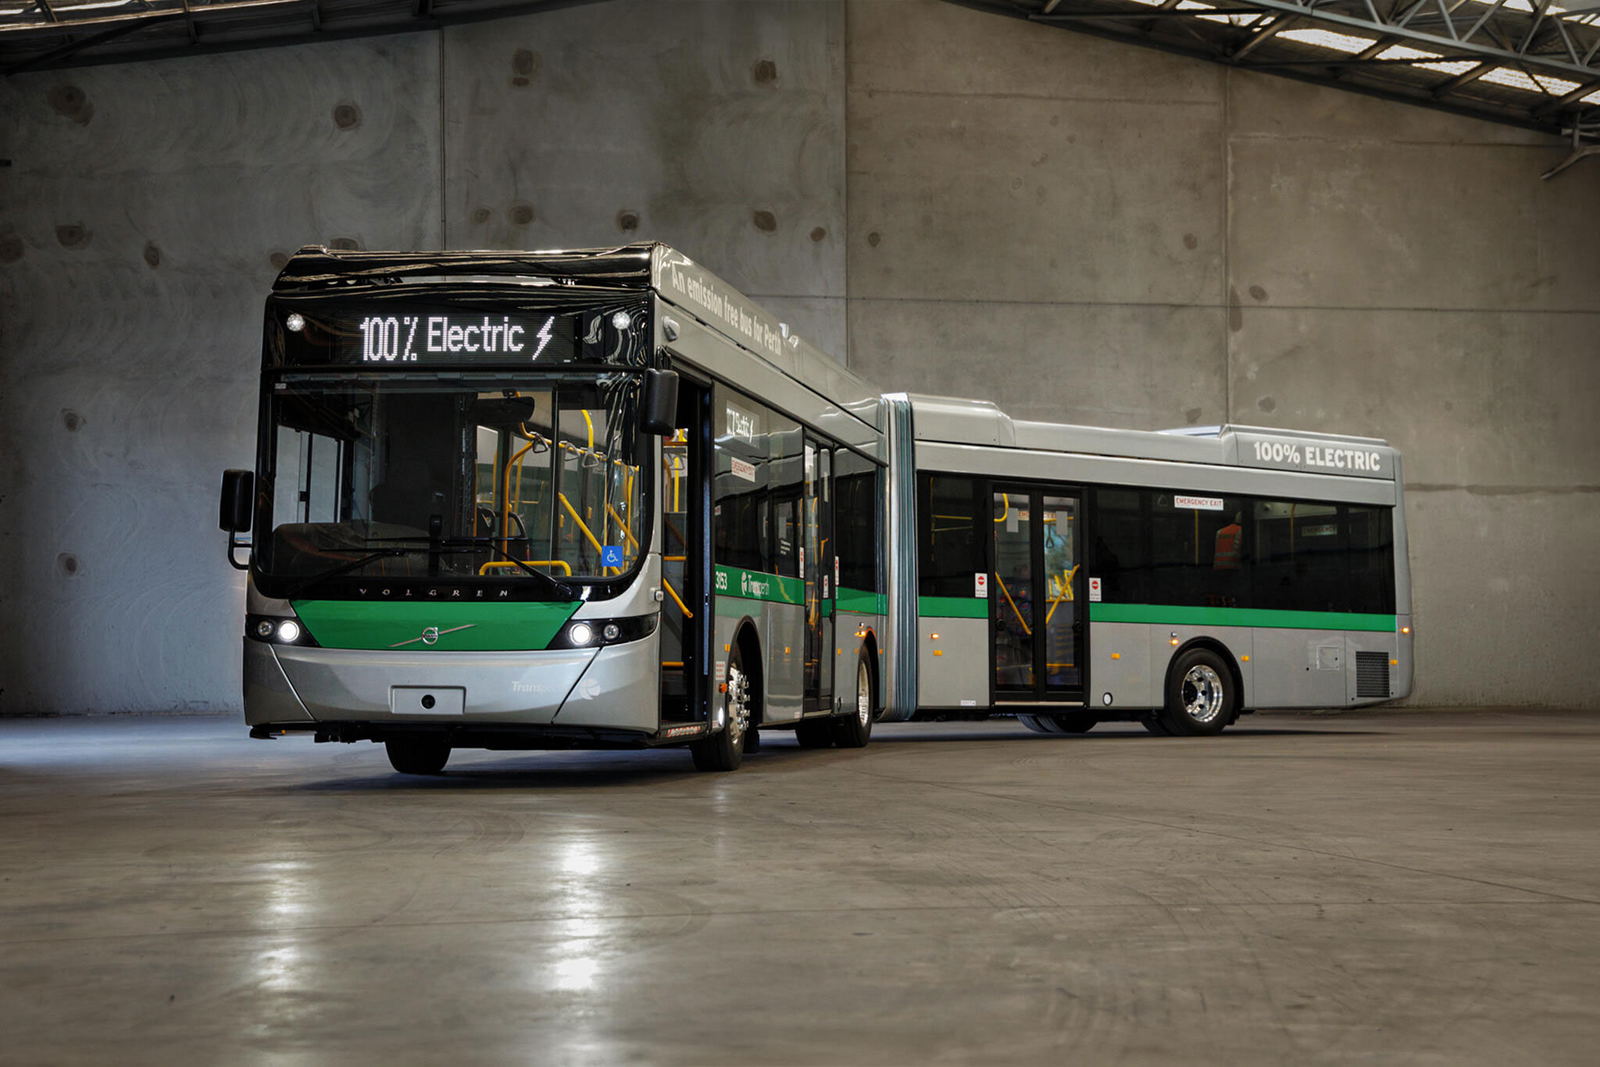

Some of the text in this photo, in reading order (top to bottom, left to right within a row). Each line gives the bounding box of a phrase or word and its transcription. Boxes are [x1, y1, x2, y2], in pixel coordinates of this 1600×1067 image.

[671, 262, 685, 293] An
[687, 277, 723, 318] emission
[725, 295, 739, 329] free
[360, 316, 525, 361] 100% Electric
[1254, 441, 1381, 471] 100% ELECTRIC
